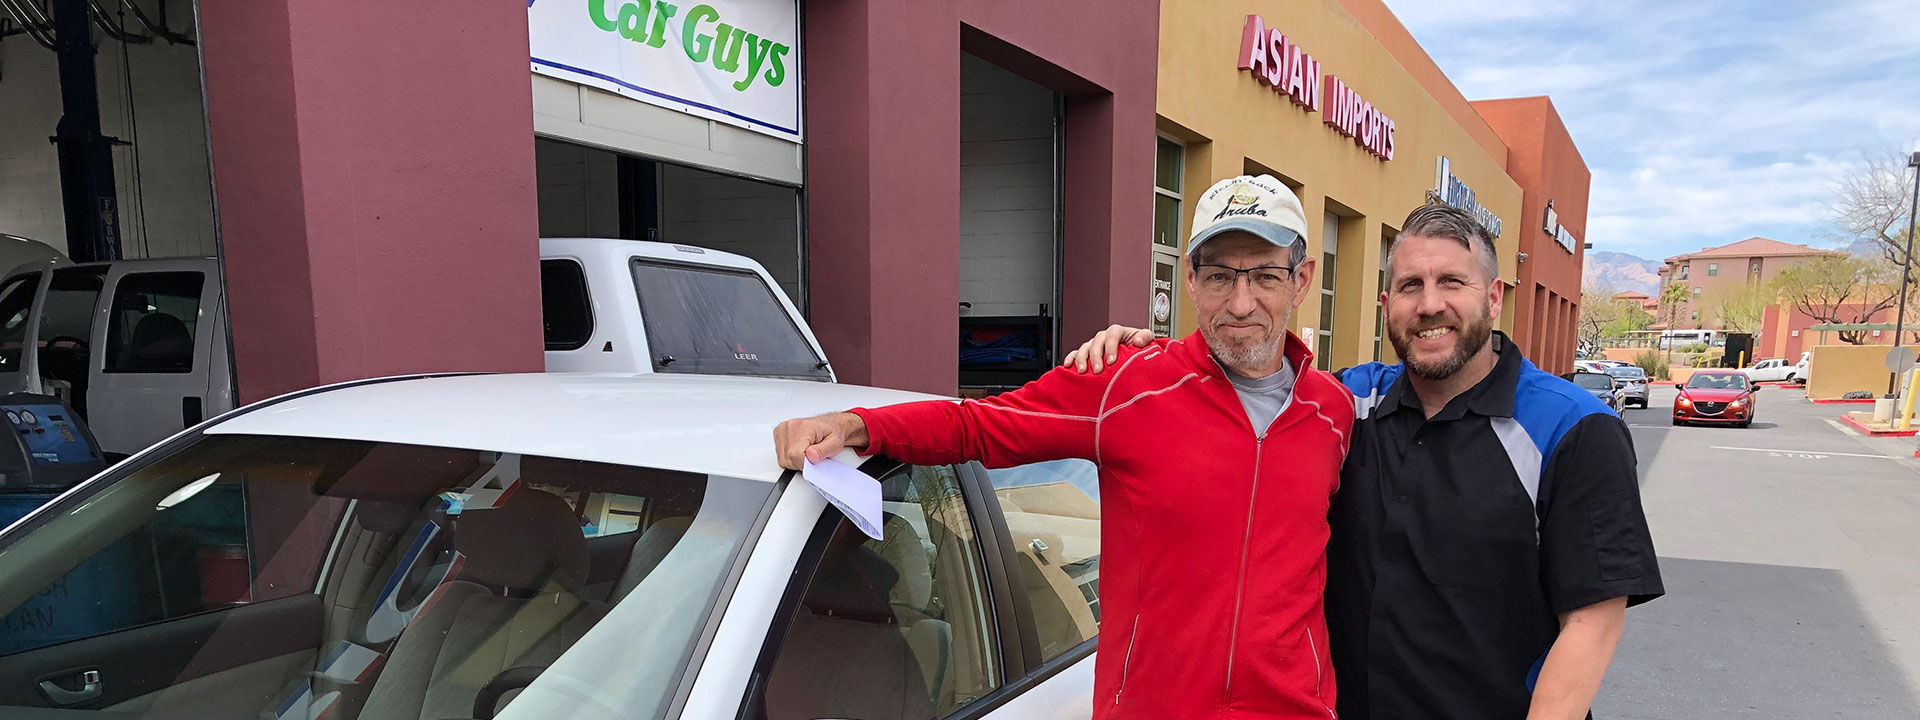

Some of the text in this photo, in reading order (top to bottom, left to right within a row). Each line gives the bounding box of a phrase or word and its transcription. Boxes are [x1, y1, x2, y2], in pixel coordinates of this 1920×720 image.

[588, 0, 789, 92] Car Guys
[1239, 14, 1395, 161] ASIAN IMPORTS
[1213, 195, 1268, 222] Aruba
[735, 353, 759, 361] LEER
